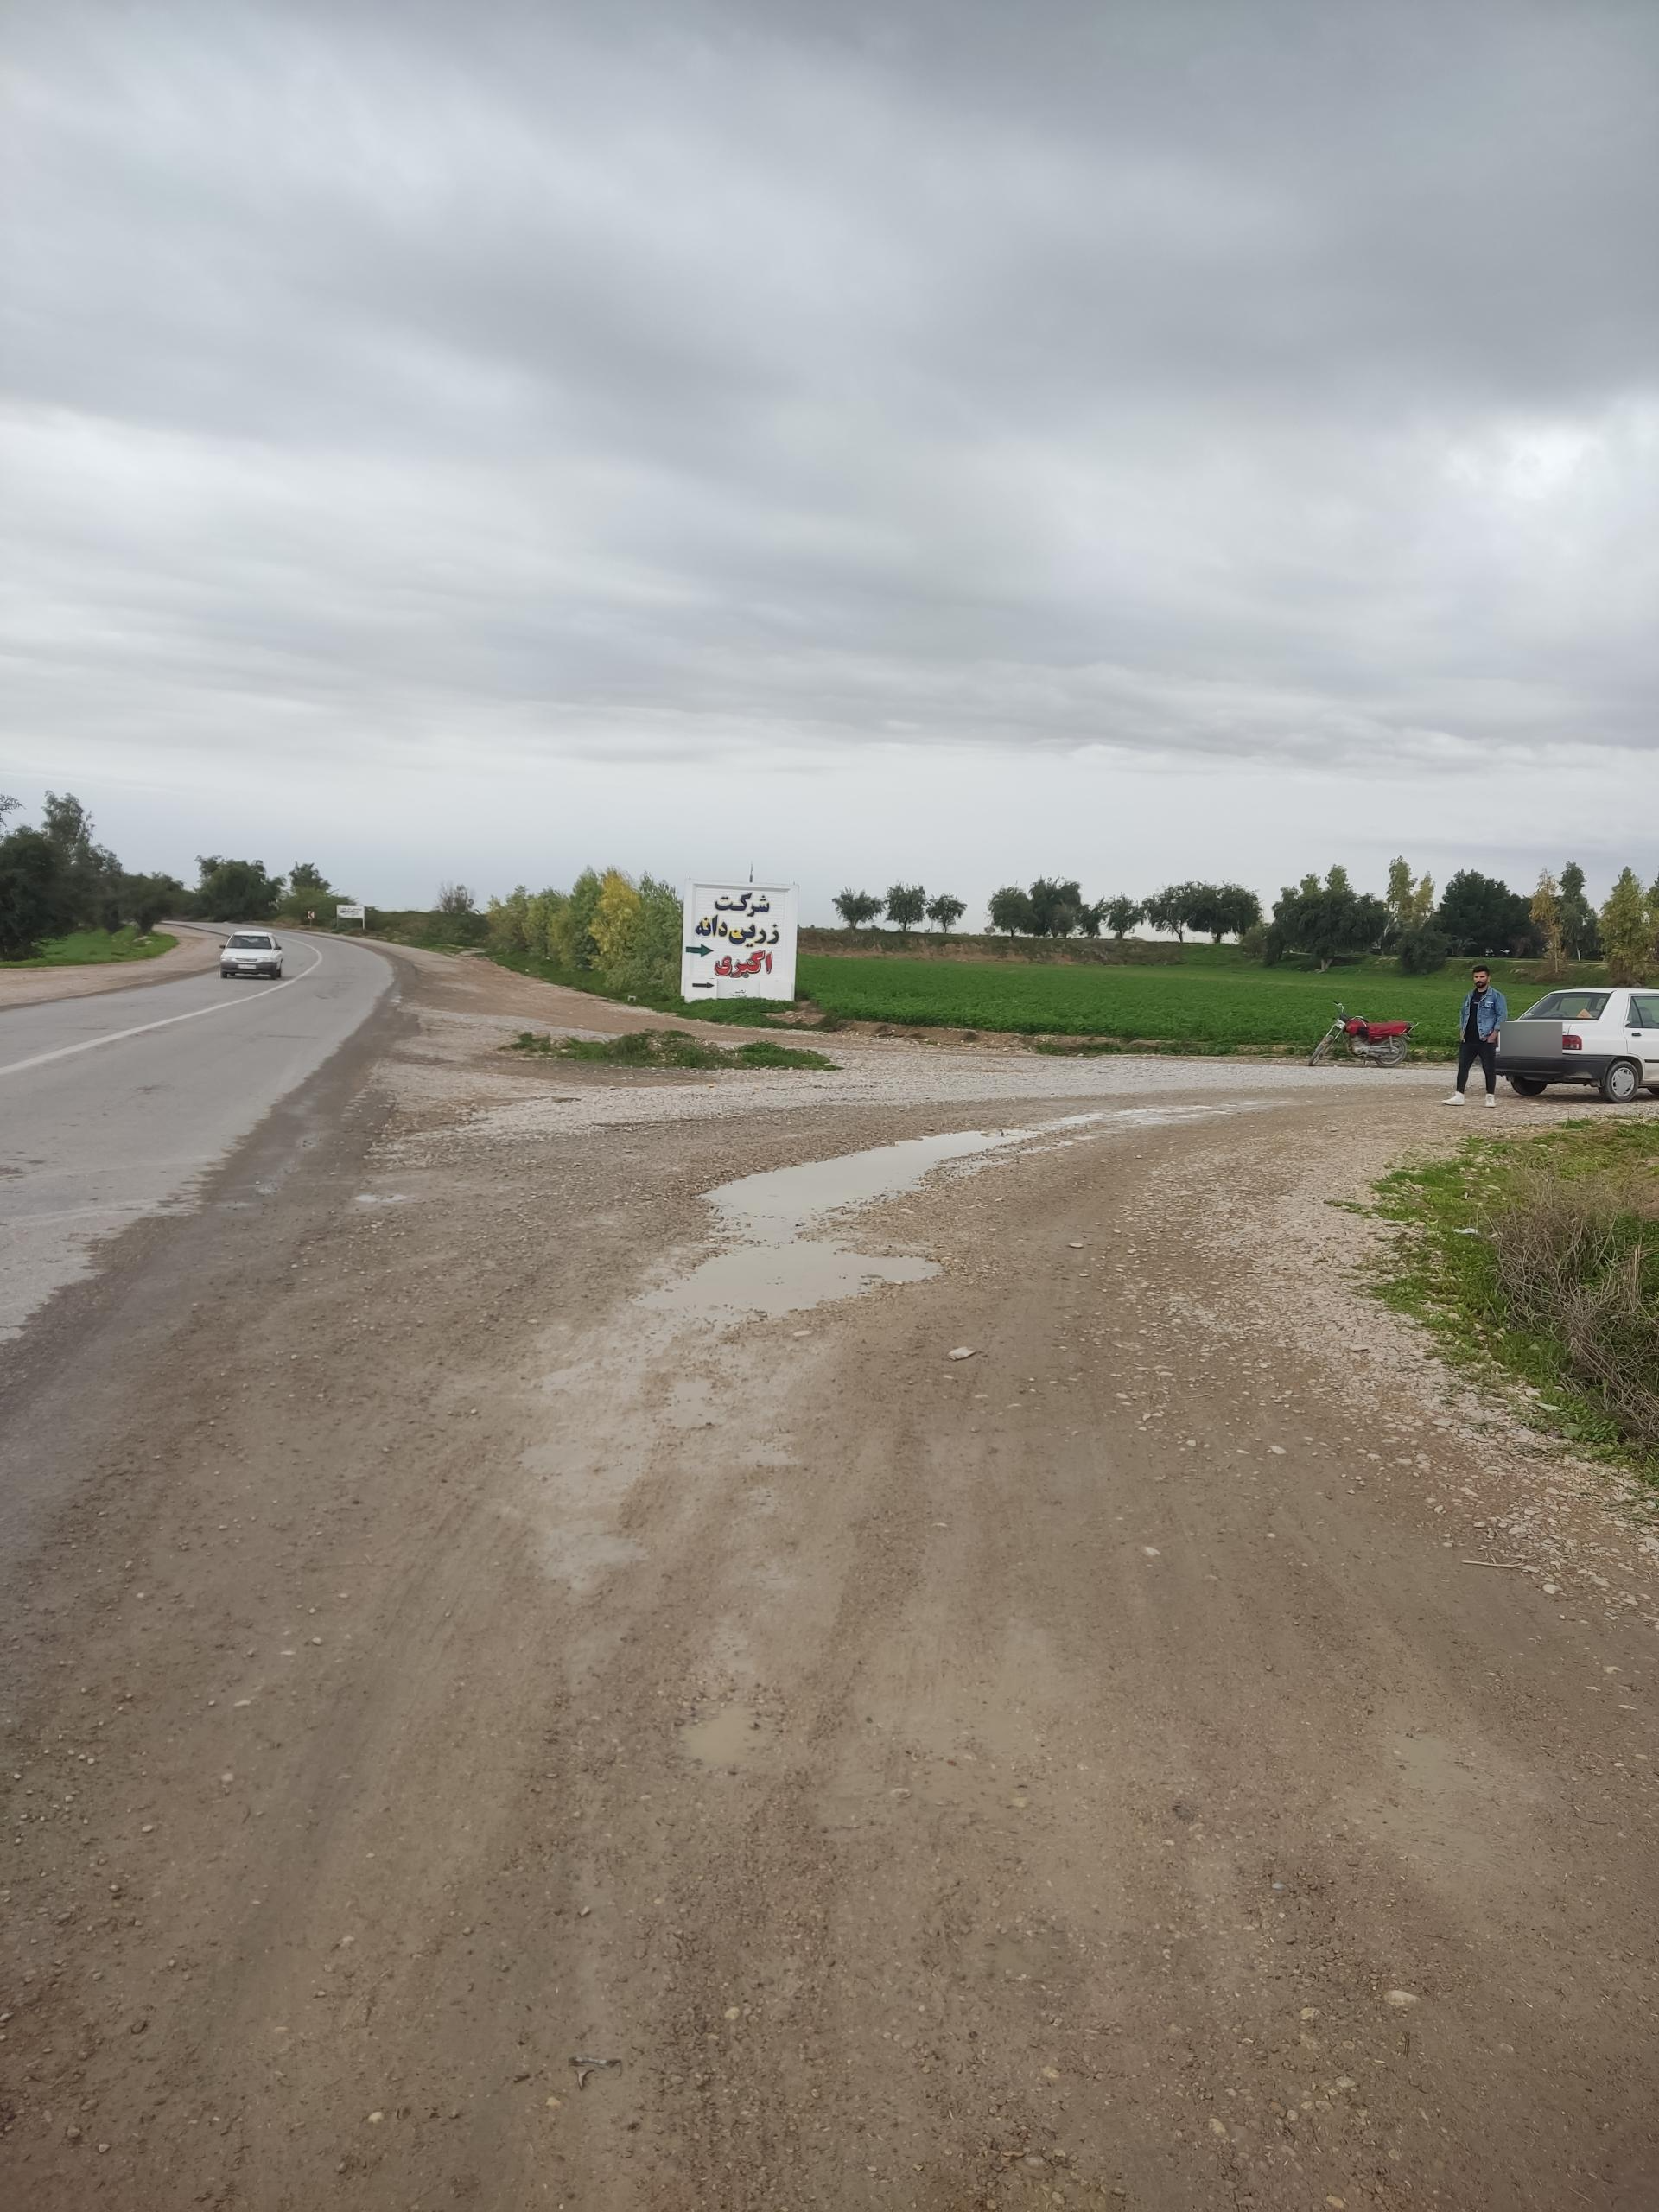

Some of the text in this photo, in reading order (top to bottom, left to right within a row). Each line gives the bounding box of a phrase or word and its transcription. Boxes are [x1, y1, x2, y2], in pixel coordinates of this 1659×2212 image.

[715, 893, 770, 917] شرکت
[695, 914, 779, 948] زرین دانه
[714, 950, 773, 978] اکبری
